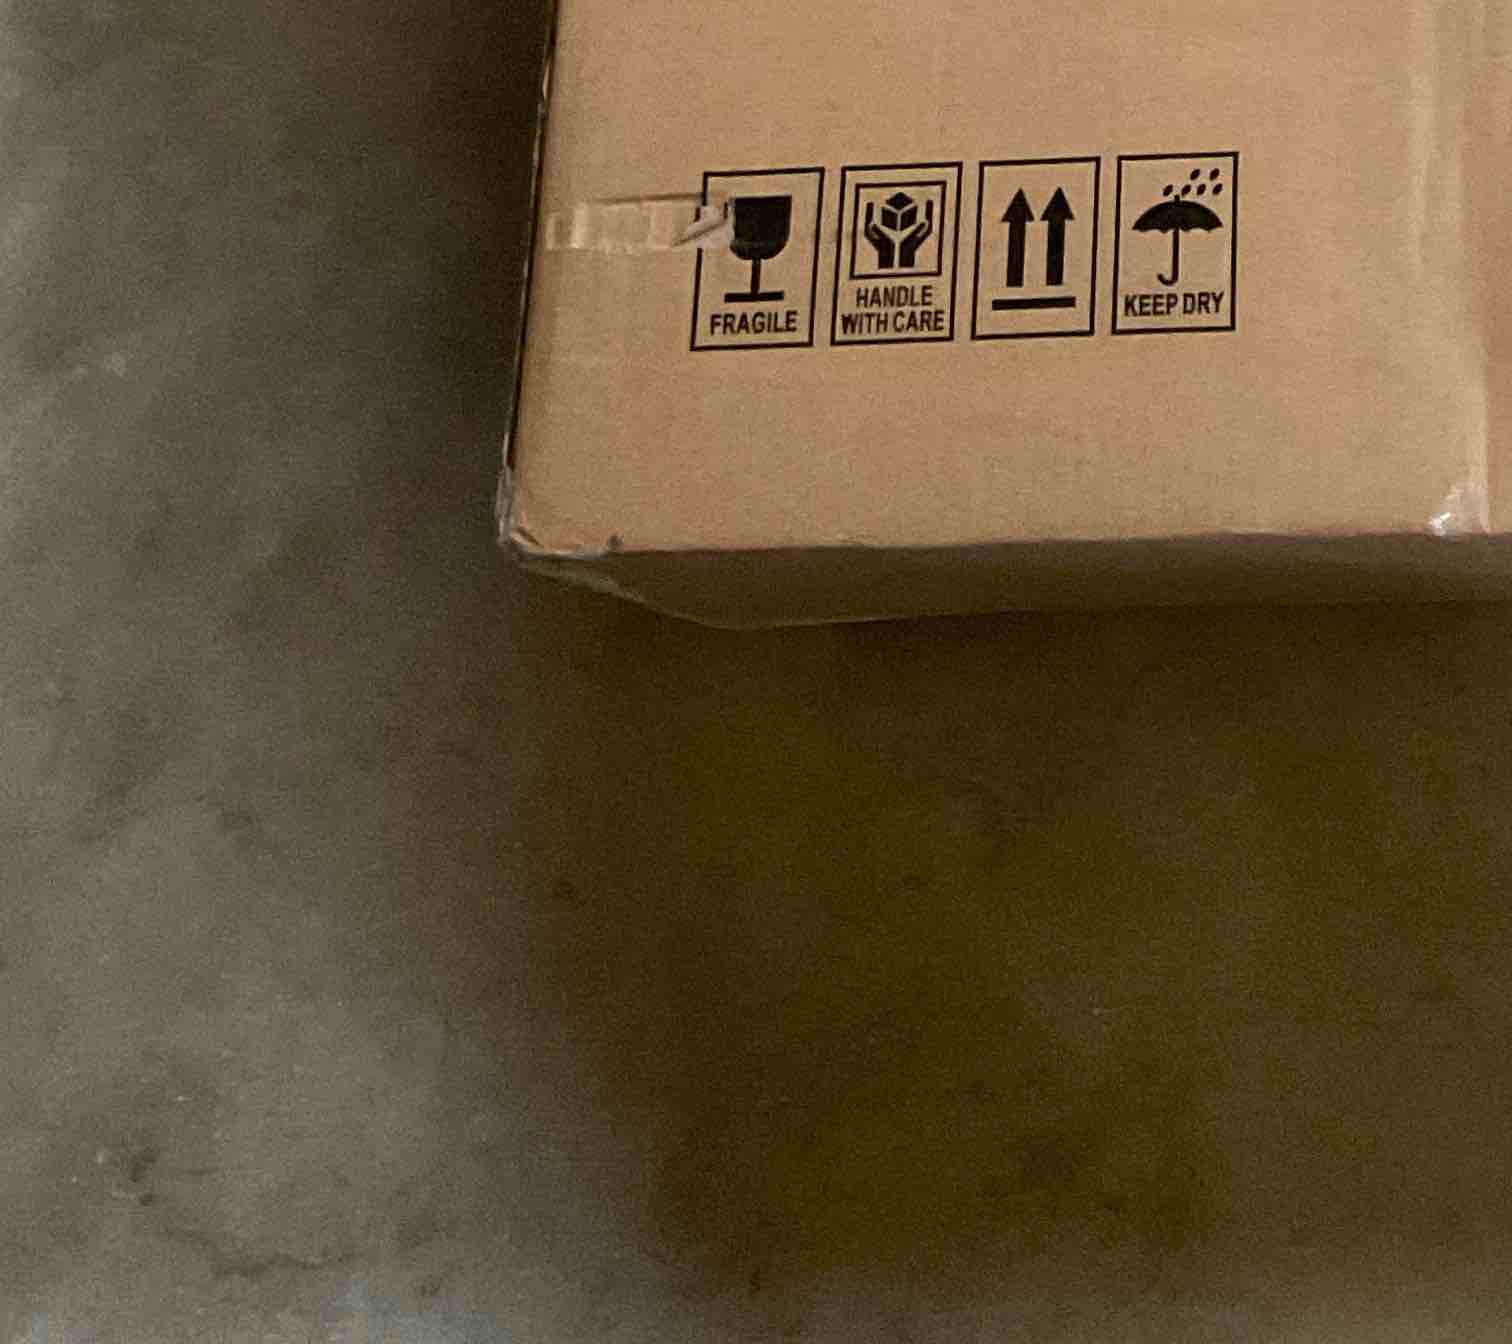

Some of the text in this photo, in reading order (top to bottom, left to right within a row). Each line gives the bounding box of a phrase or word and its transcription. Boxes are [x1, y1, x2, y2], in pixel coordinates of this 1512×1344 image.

[856, 285, 932, 308] HANDLE
[1125, 292, 1224, 317] KEEP DRY
[710, 310, 797, 336] FRAGILE
[841, 309, 944, 334] WITH CARE
